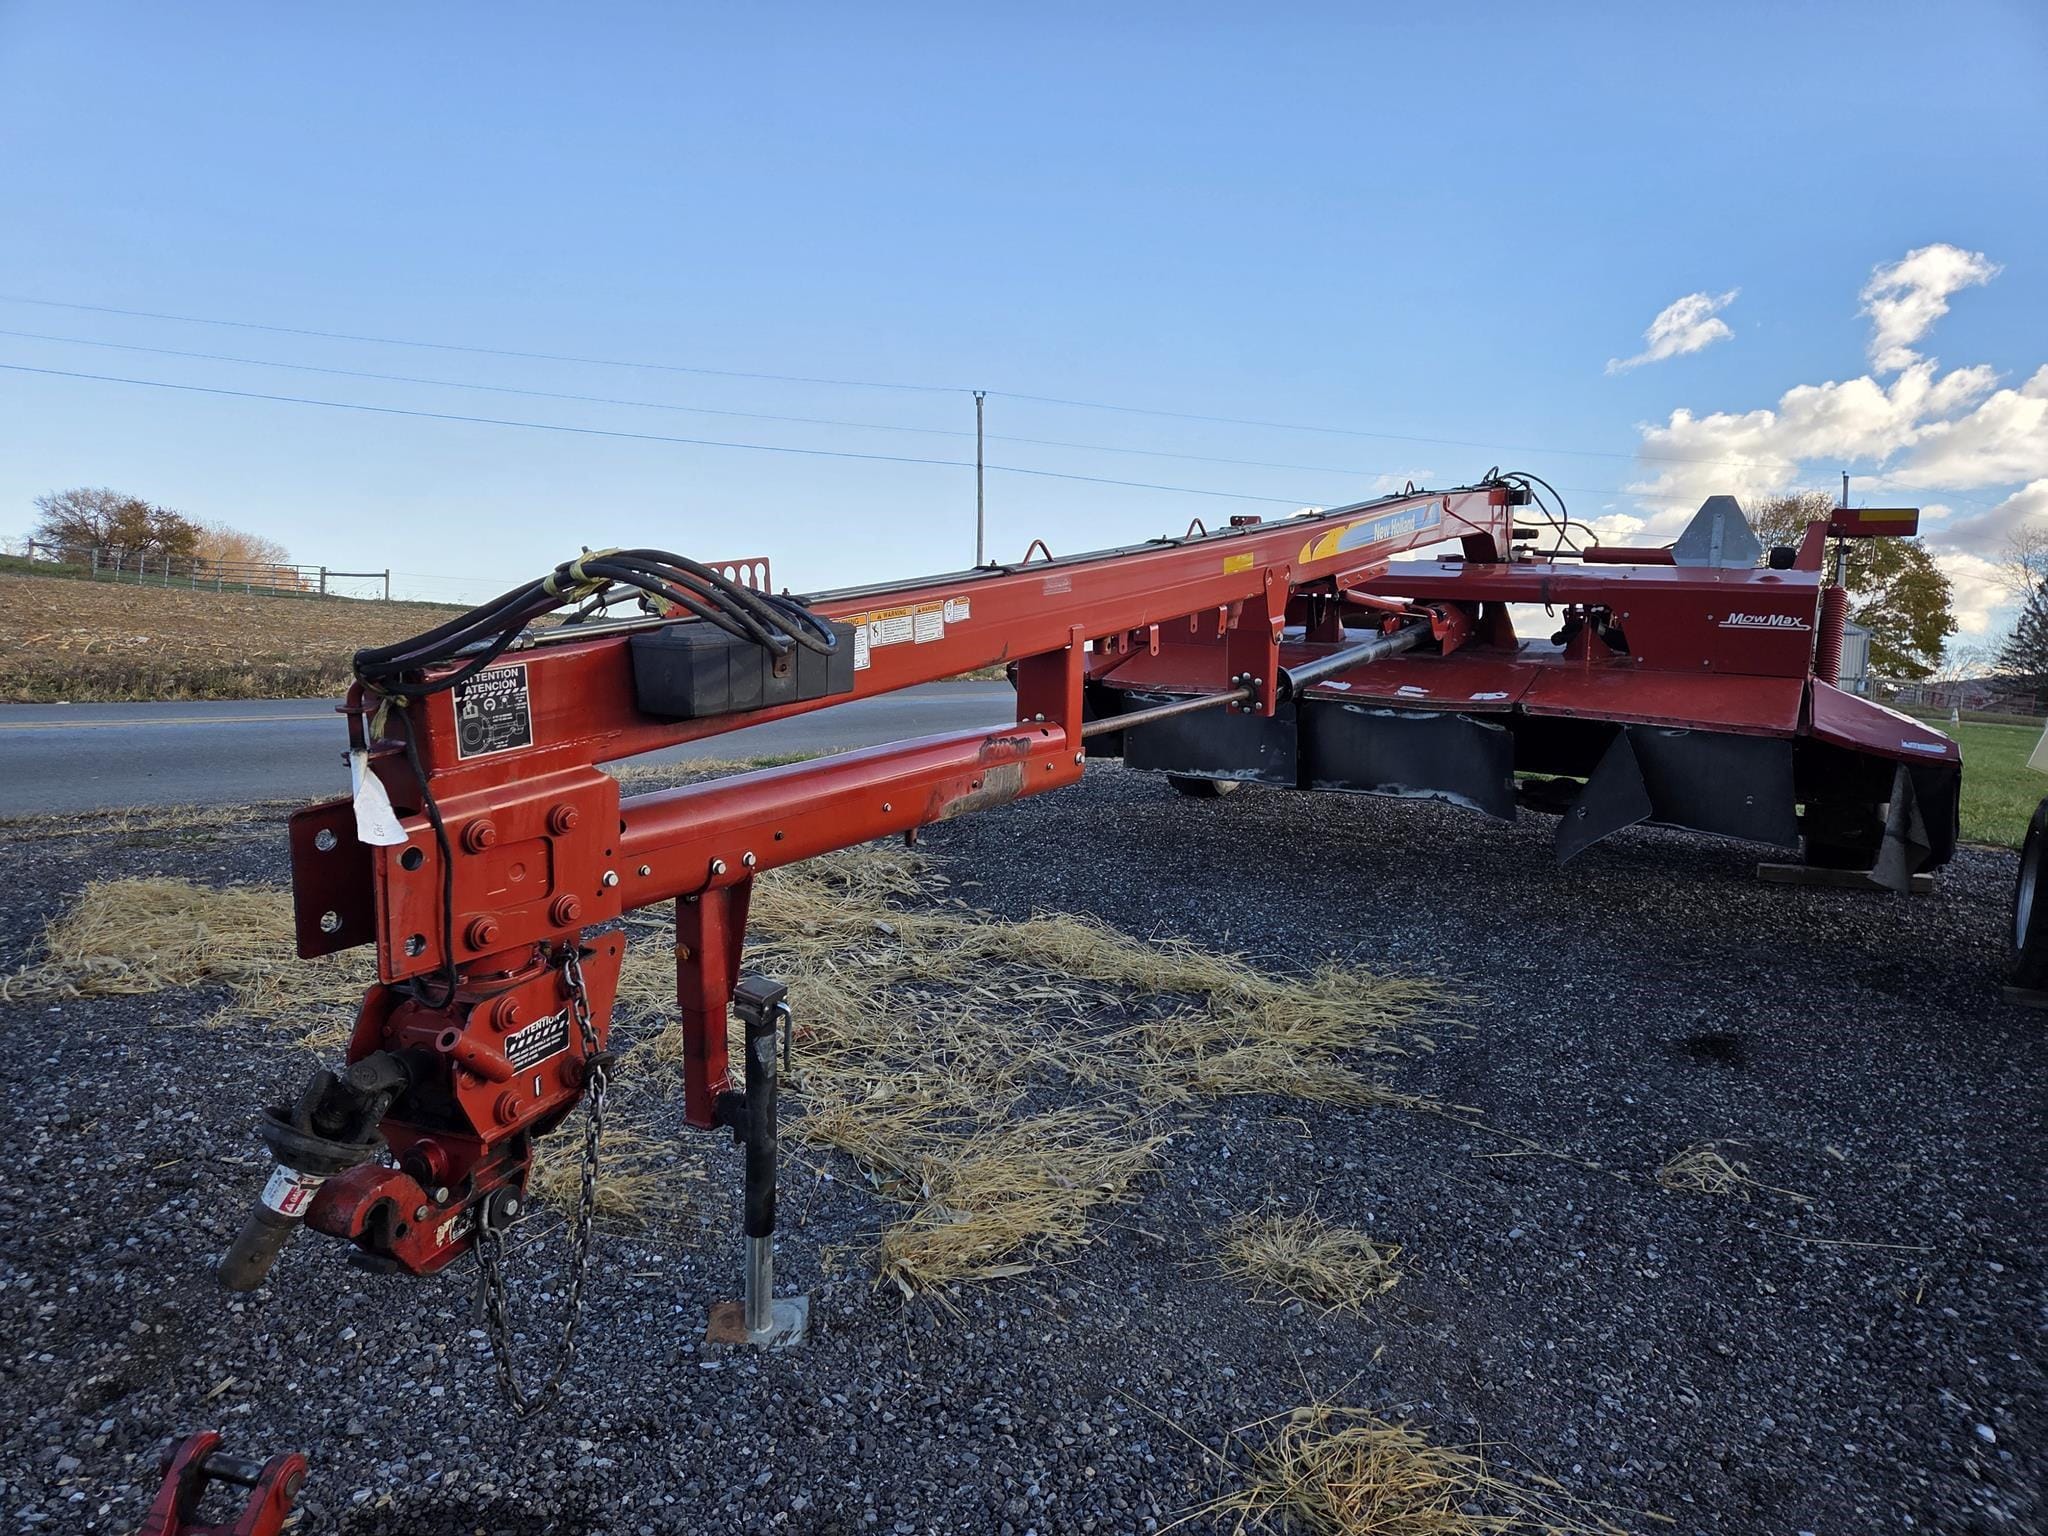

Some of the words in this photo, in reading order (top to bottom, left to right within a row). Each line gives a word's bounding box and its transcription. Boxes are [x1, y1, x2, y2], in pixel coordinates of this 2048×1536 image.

[1374, 522, 1390, 541] New
[1391, 513, 1415, 537] Holland
[883, 609, 907, 618] WARNING
[465, 678, 517, 695] ATENCIÓN
